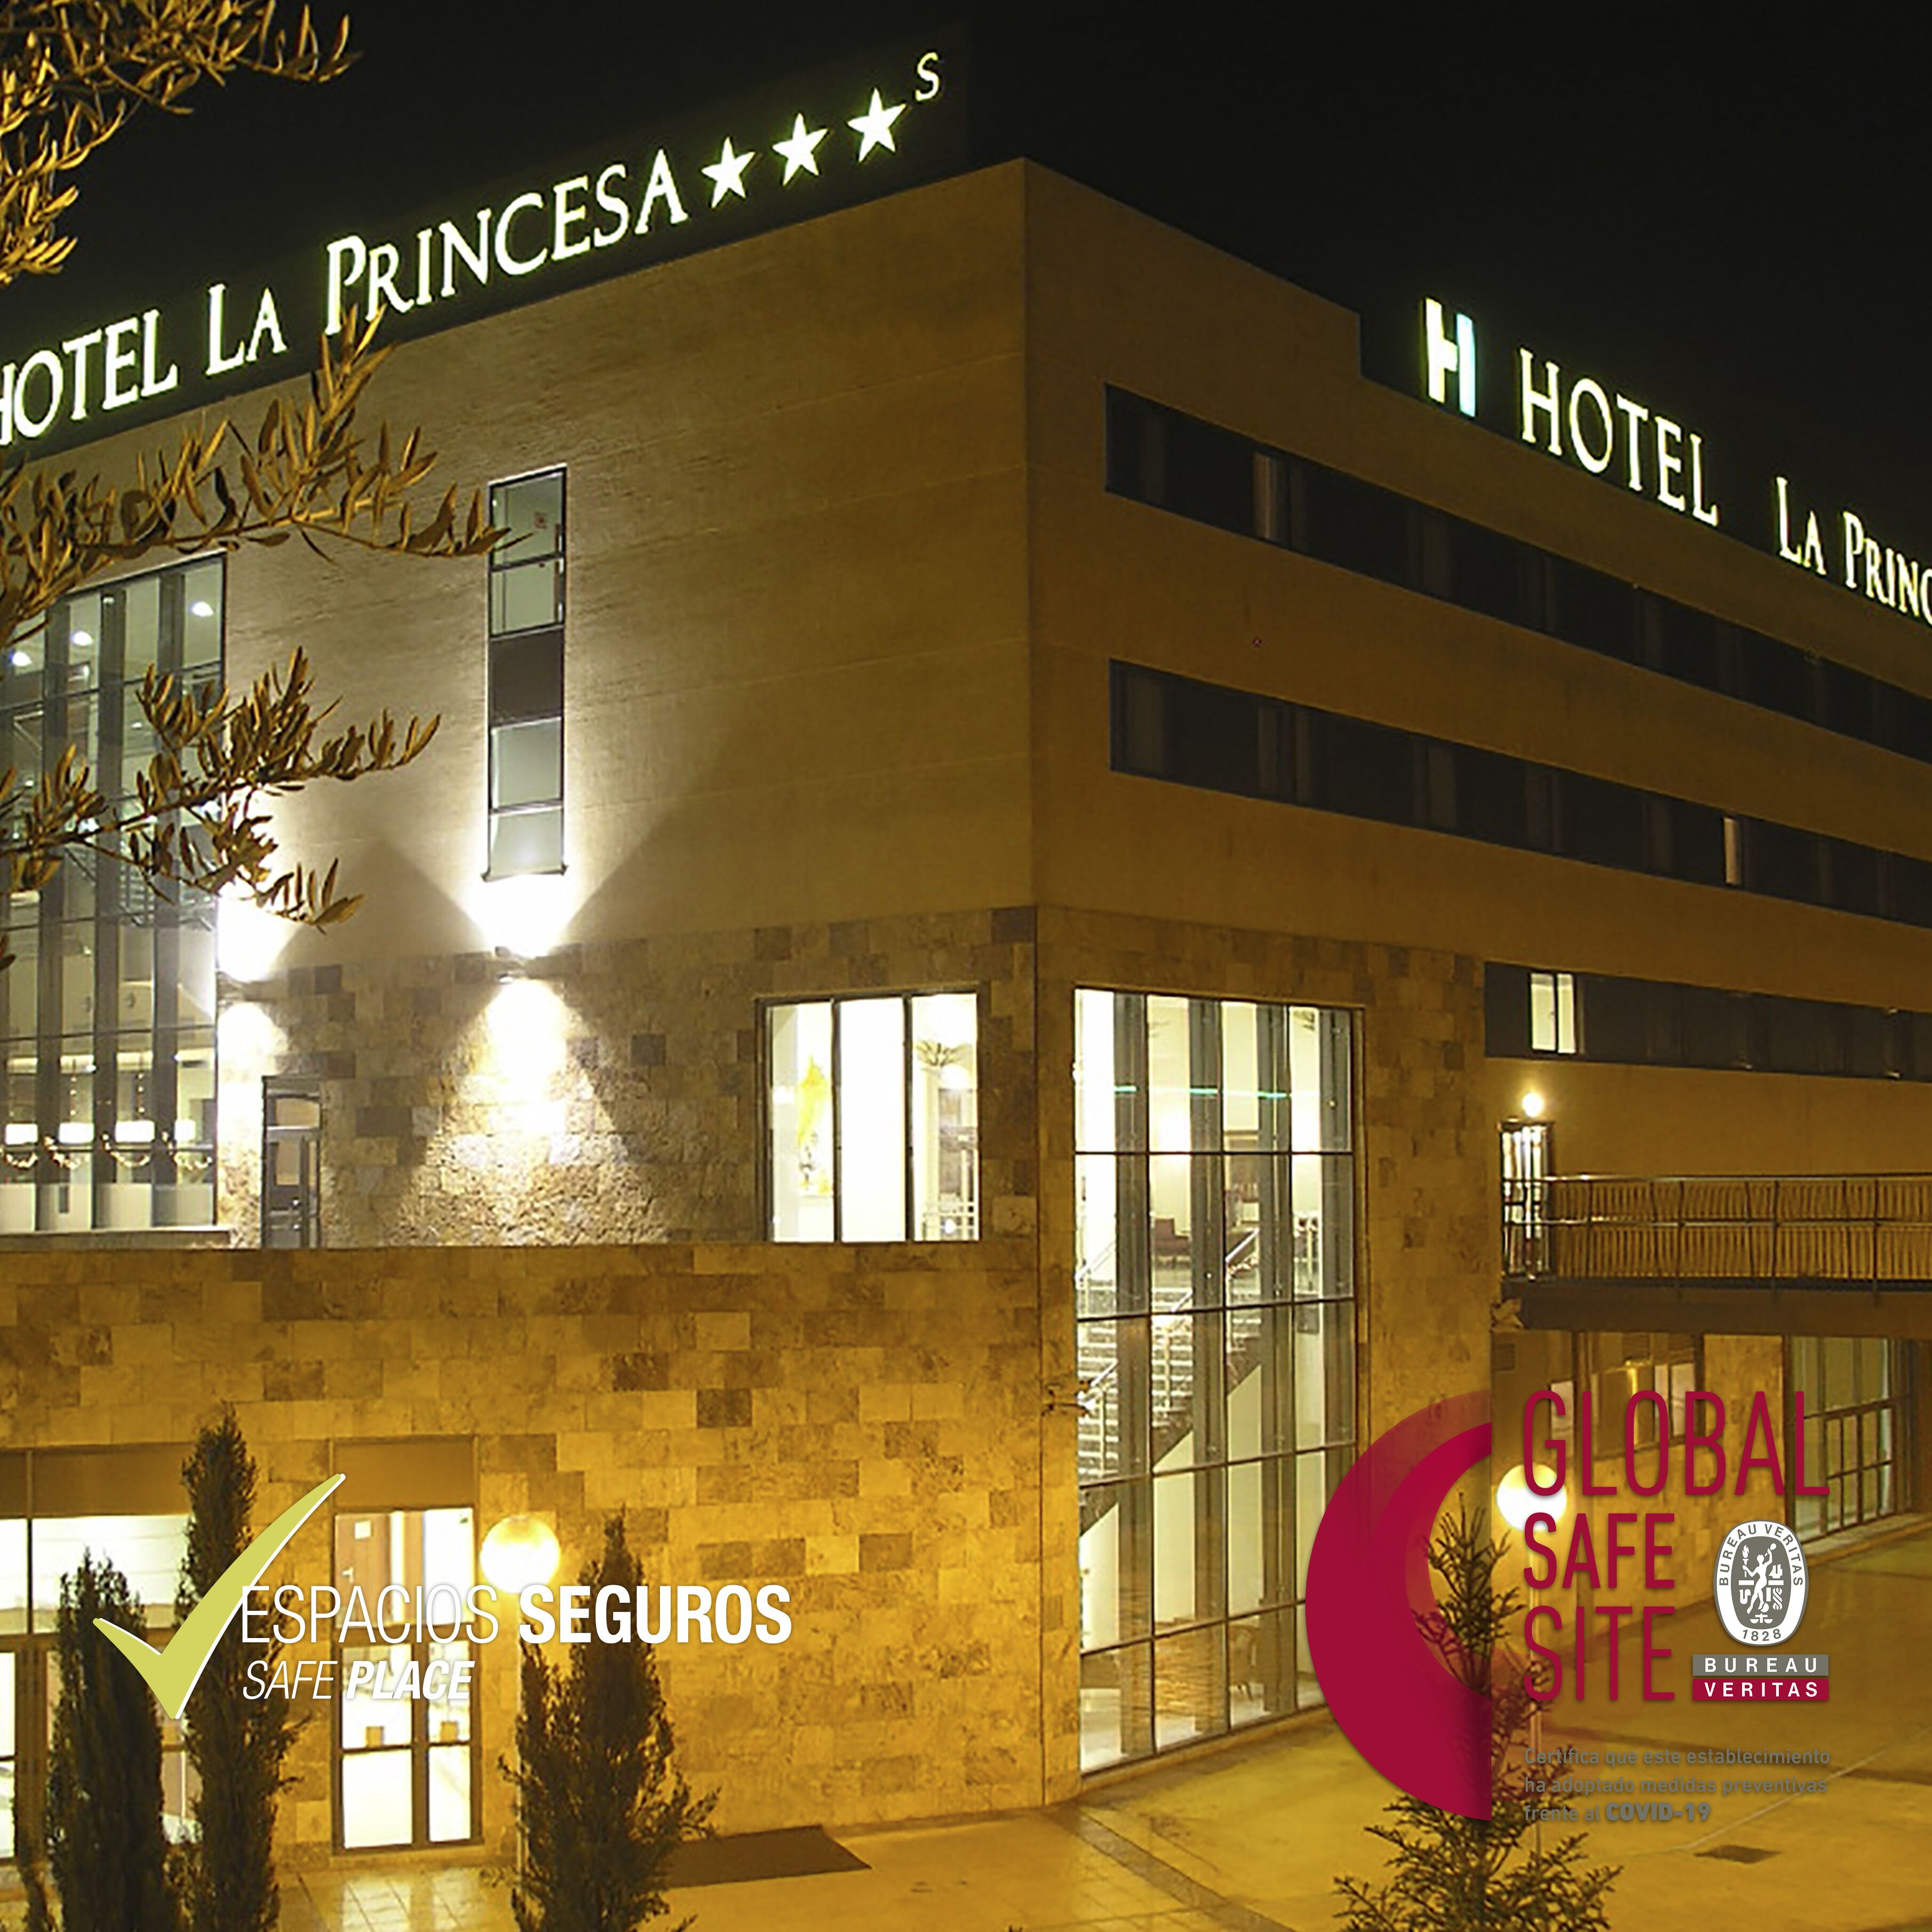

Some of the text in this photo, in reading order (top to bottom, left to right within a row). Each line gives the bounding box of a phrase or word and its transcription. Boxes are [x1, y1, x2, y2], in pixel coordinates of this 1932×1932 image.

[206, 284, 287, 375] LA
[325, 149, 688, 336] PRINCESA
[1520, 348, 1718, 526] HOTEL
[1777, 477, 1826, 575] LA
